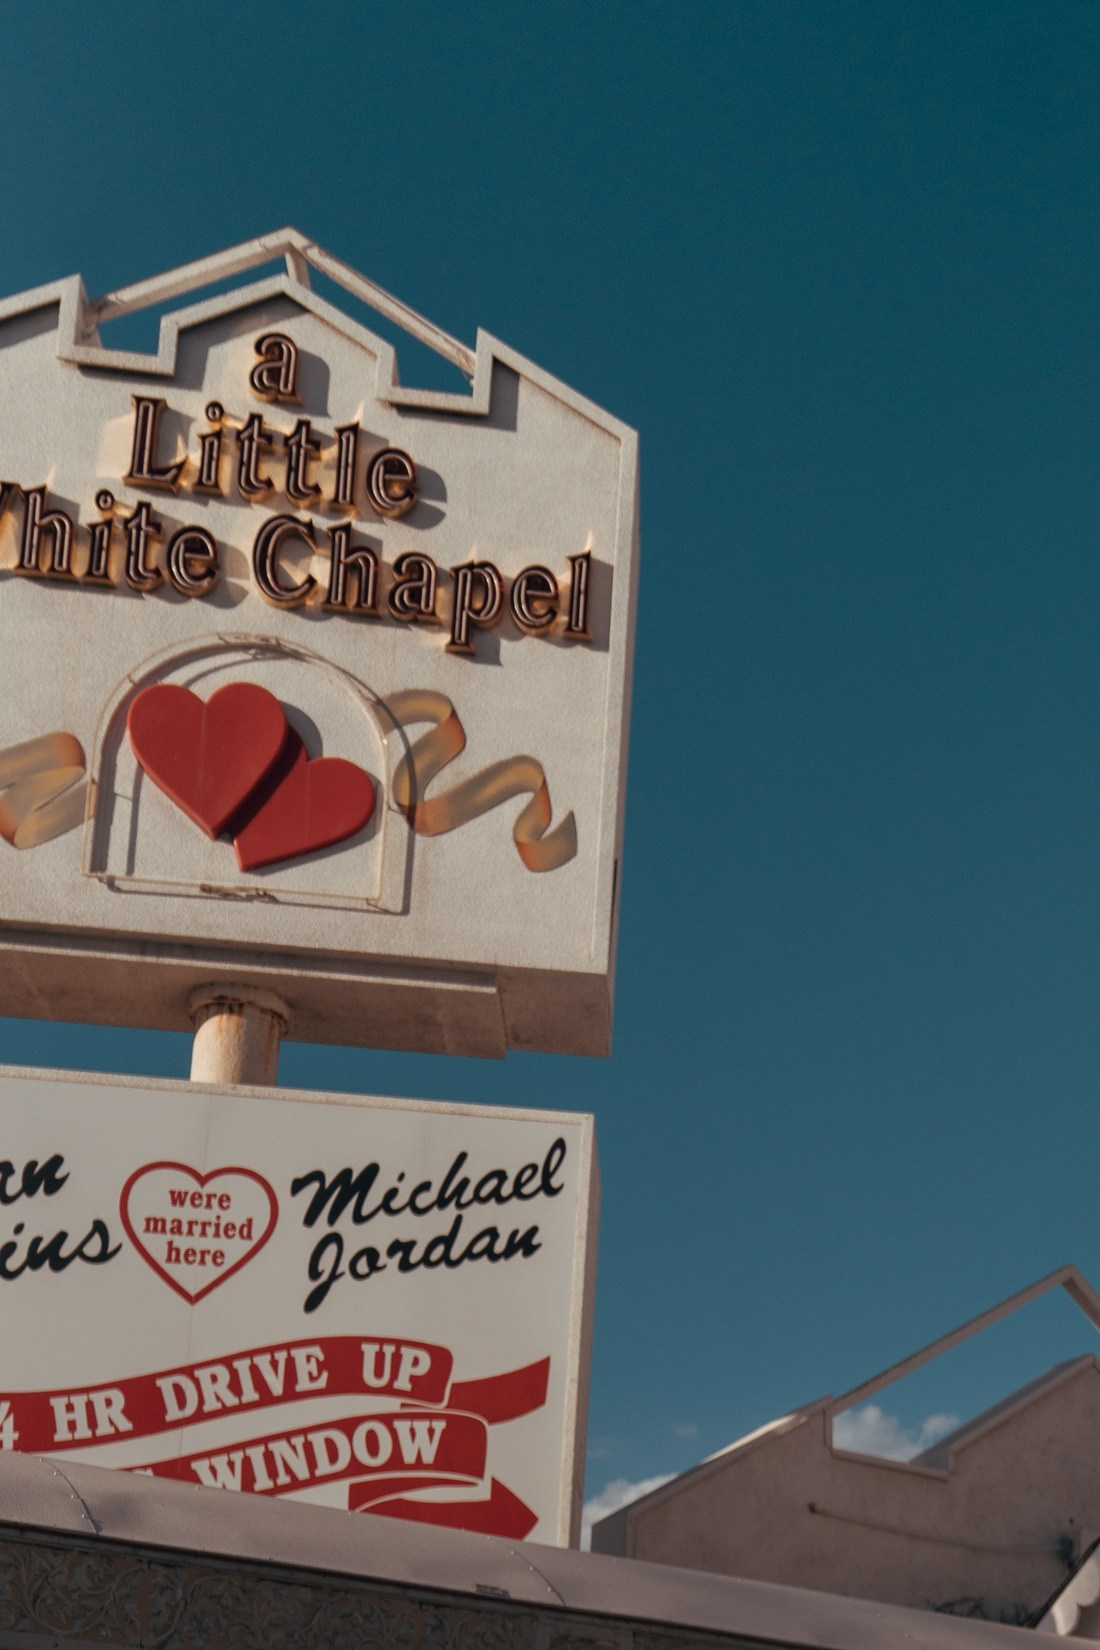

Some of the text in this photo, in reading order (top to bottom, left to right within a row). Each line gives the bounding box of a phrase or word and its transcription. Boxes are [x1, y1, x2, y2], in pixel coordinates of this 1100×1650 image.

[250, 332, 301, 404] a
[122, 394, 418, 518] Little
[0, 481, 593, 655] hite Chapel
[169, 1189, 232, 1211] were
[290, 1137, 567, 1229] Michael
[143, 1214, 254, 1241] married
[165, 1240, 226, 1267] here
[303, 1213, 542, 1314] Jordan
[49, 1387, 134, 1442] HR
[155, 1344, 329, 1423] DRIVE
[360, 1342, 432, 1393] UP
[190, 1420, 447, 1492] WINDOW
